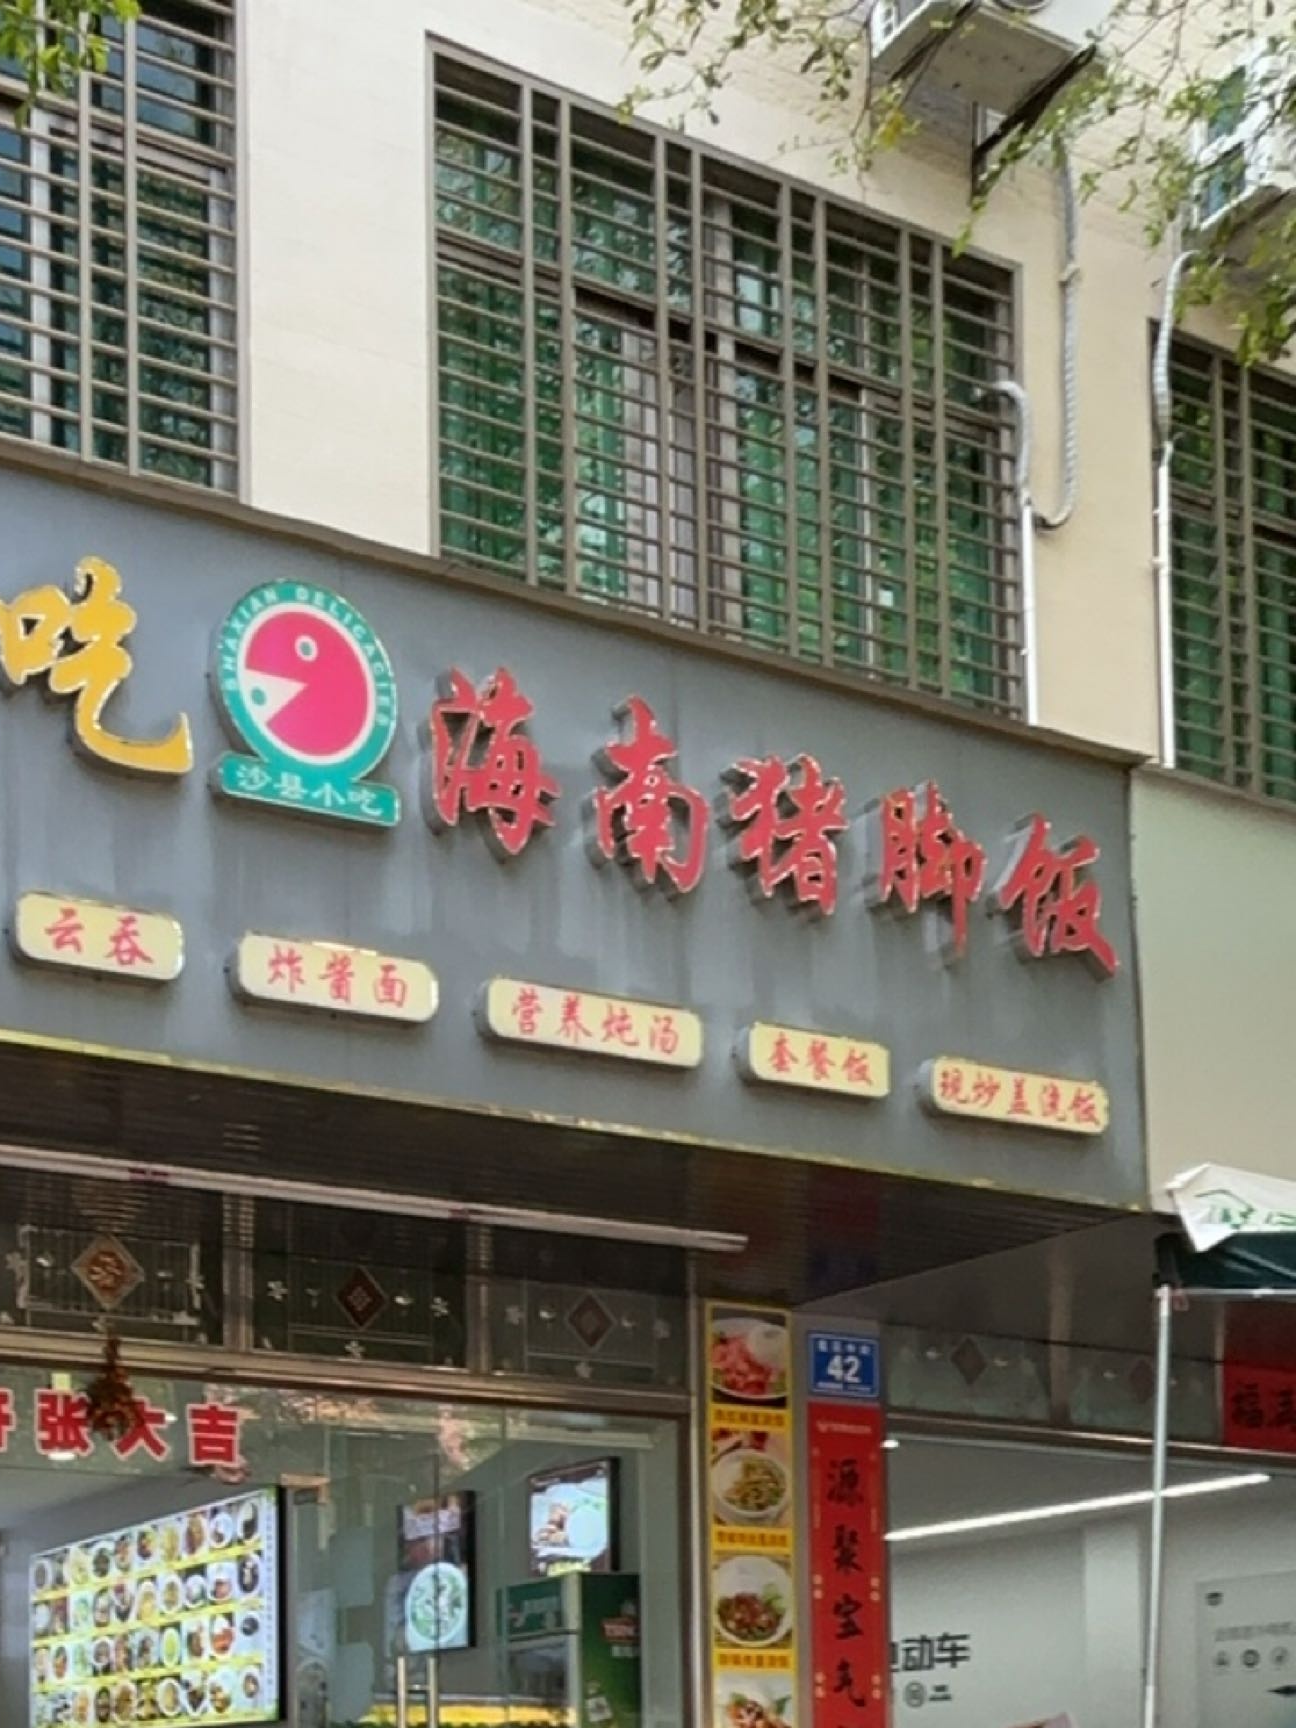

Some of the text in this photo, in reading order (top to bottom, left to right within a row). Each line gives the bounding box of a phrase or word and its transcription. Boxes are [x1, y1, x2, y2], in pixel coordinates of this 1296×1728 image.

[222, 586, 391, 727] SHAXIAN DELICACIES
[235, 763, 383, 816] 沙县小吃
[430, 666, 1119, 977] 海南猪脚饭
[44, 906, 154, 966] 云吞
[267, 946, 408, 1007] 炸酱面
[512, 987, 680, 1054] 营养炖汤
[768, 1030, 874, 1086] 套餐饭
[827, 1354, 862, 1384] 42
